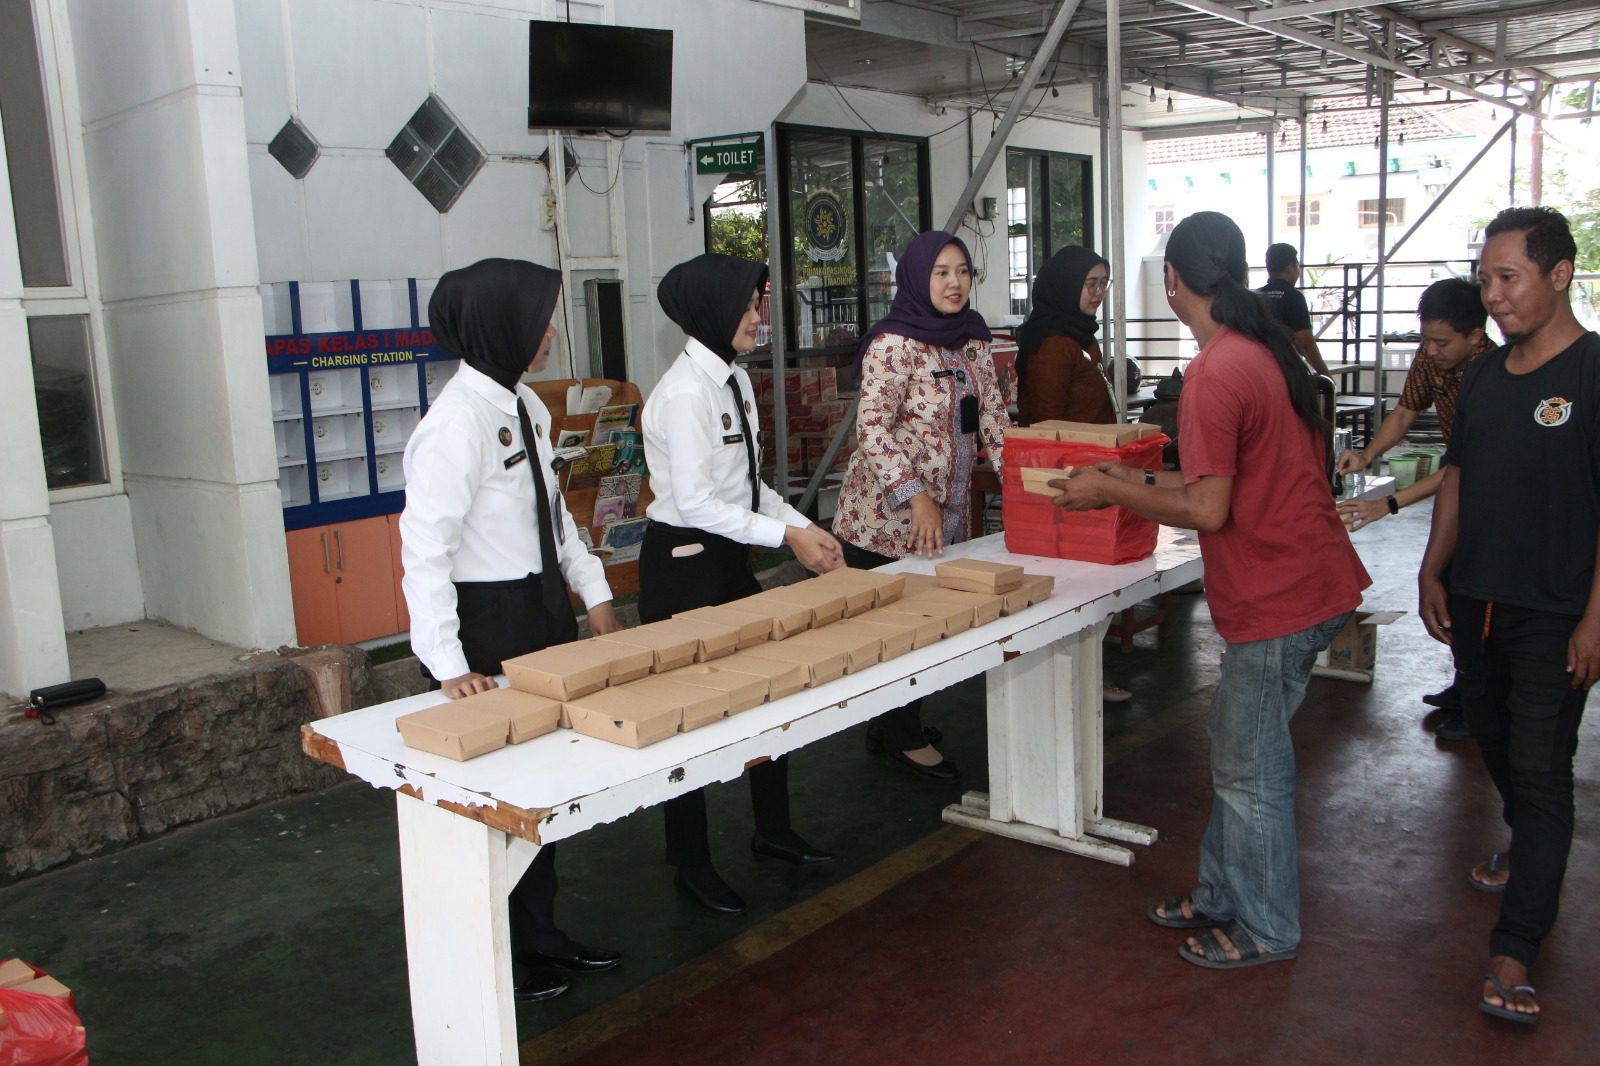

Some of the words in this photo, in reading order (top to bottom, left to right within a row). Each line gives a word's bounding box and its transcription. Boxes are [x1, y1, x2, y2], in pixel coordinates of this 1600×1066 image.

[716, 150, 754, 166] TOILET
[802, 266, 852, 276] PRIMKOPASINDO
[828, 276, 851, 286] MADIUN
[317, 333, 379, 353] KELAS
[383, 332, 391, 349] I
[395, 330, 439, 347] MAD
[312, 354, 368, 368] CHARGING
[371, 350, 413, 364] STATION
